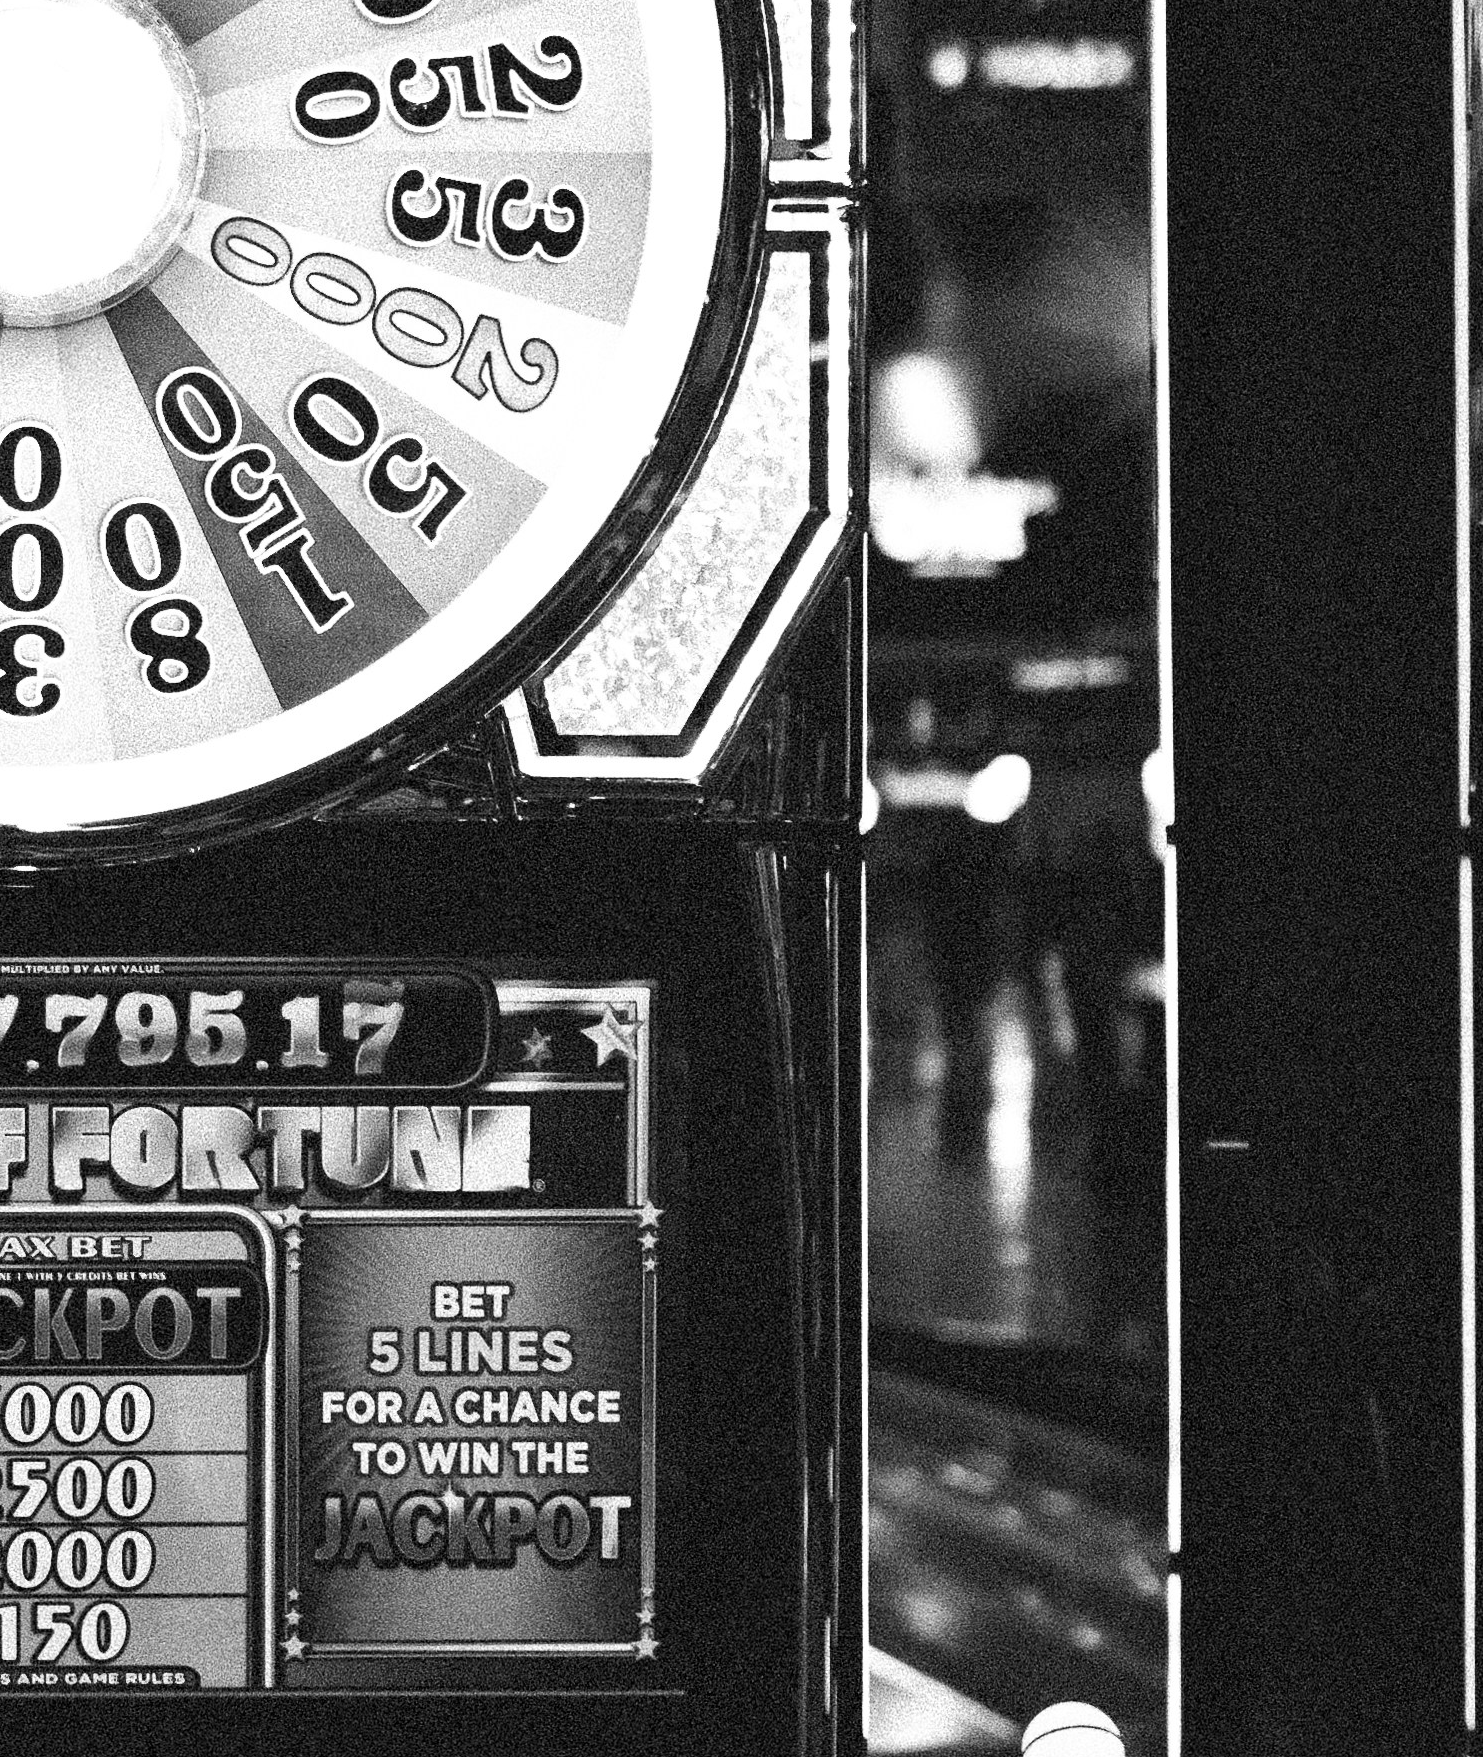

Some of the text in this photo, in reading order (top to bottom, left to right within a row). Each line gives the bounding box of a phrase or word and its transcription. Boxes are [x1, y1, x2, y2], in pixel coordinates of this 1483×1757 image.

[292, 35, 584, 144] 250
[386, 168, 587, 263] 35
[210, 216, 559, 412] 2000
[289, 373, 470, 542] 50
[155, 365, 354, 634] 150
[100, 498, 212, 695] 80
[70, 1236, 151, 1259] BET
[434, 1285, 511, 1319] BET
[369, 1331, 574, 1373] 5 LINES
[322, 1390, 621, 1425] FOR A CHANCE
[354, 1442, 589, 1474] TO WIN THE
[319, 1491, 632, 1565] JACKPOT
[11, 1673, 57, 1687] AND
[64, 1673, 119, 1687] GAME
[127, 1673, 186, 1687] RULES
